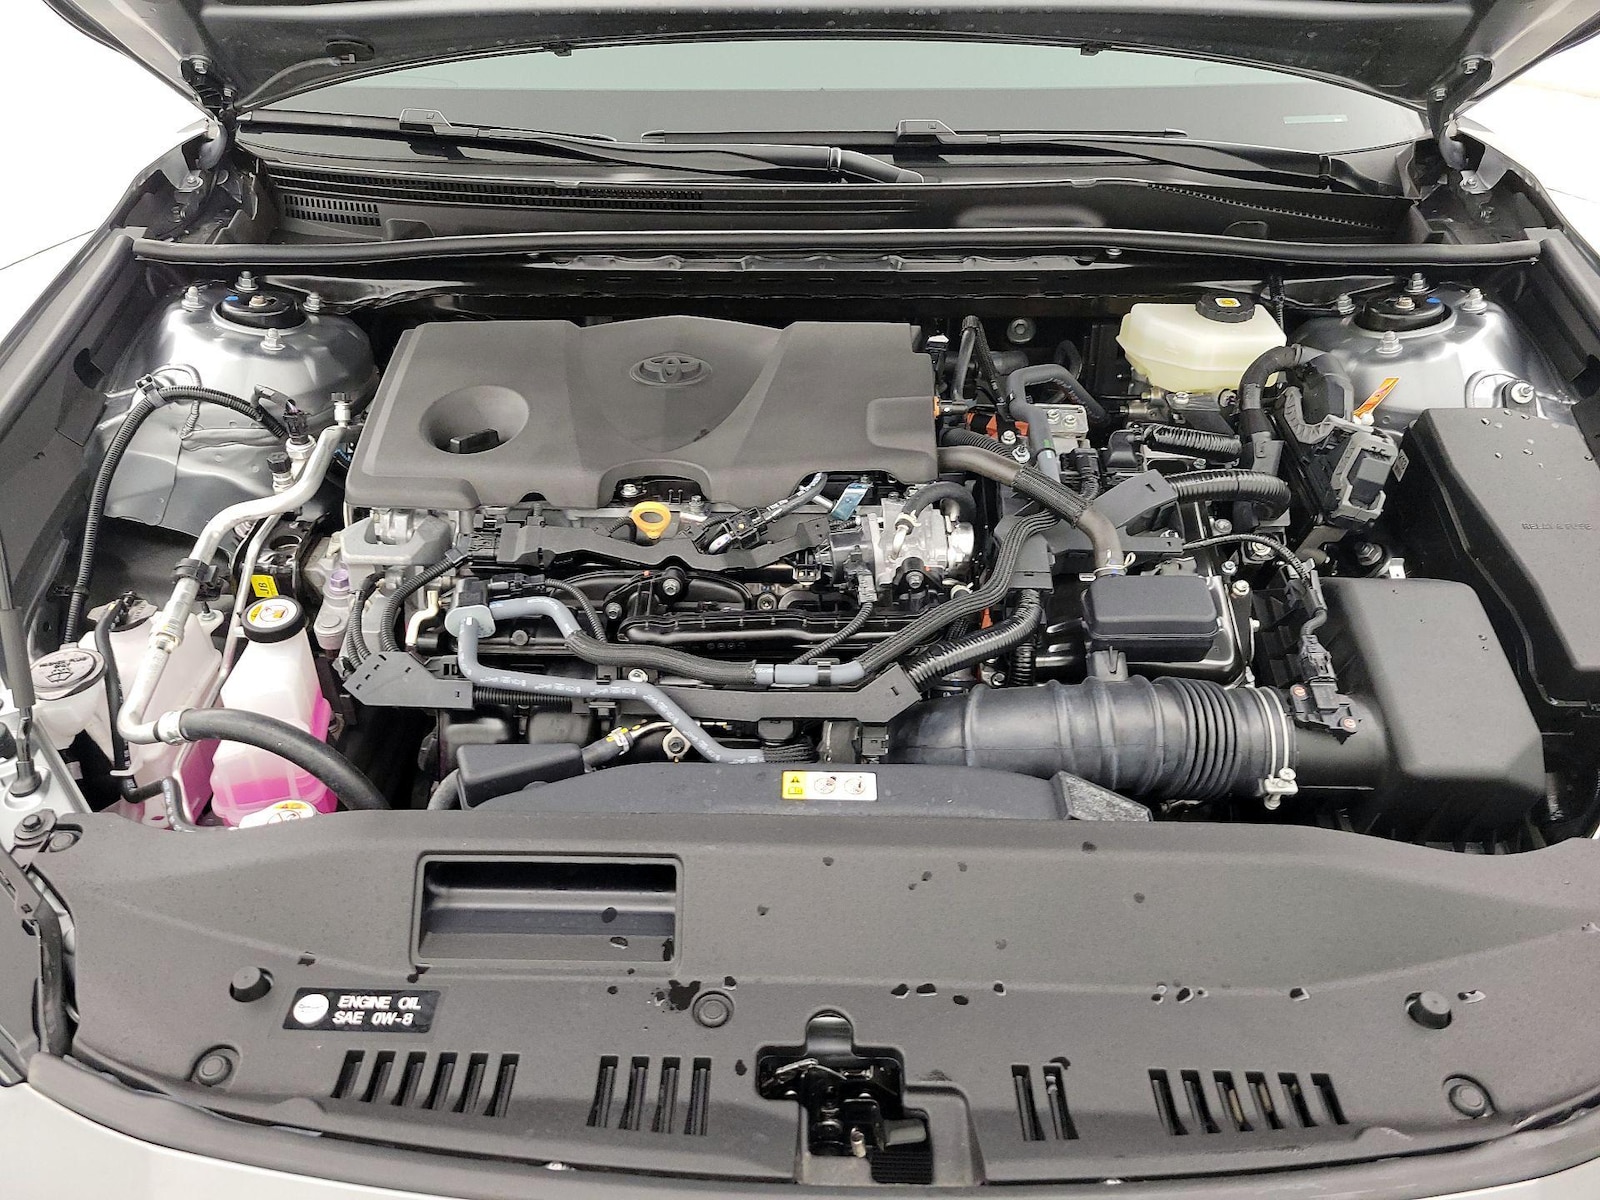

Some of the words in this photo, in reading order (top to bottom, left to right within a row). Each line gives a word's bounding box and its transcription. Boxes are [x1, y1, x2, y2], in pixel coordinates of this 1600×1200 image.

[337, 995, 392, 1010] ENGINE
[397, 996, 422, 1011] OIL
[332, 1010, 365, 1025] SAE
[371, 1011, 415, 1026] 0W-8
